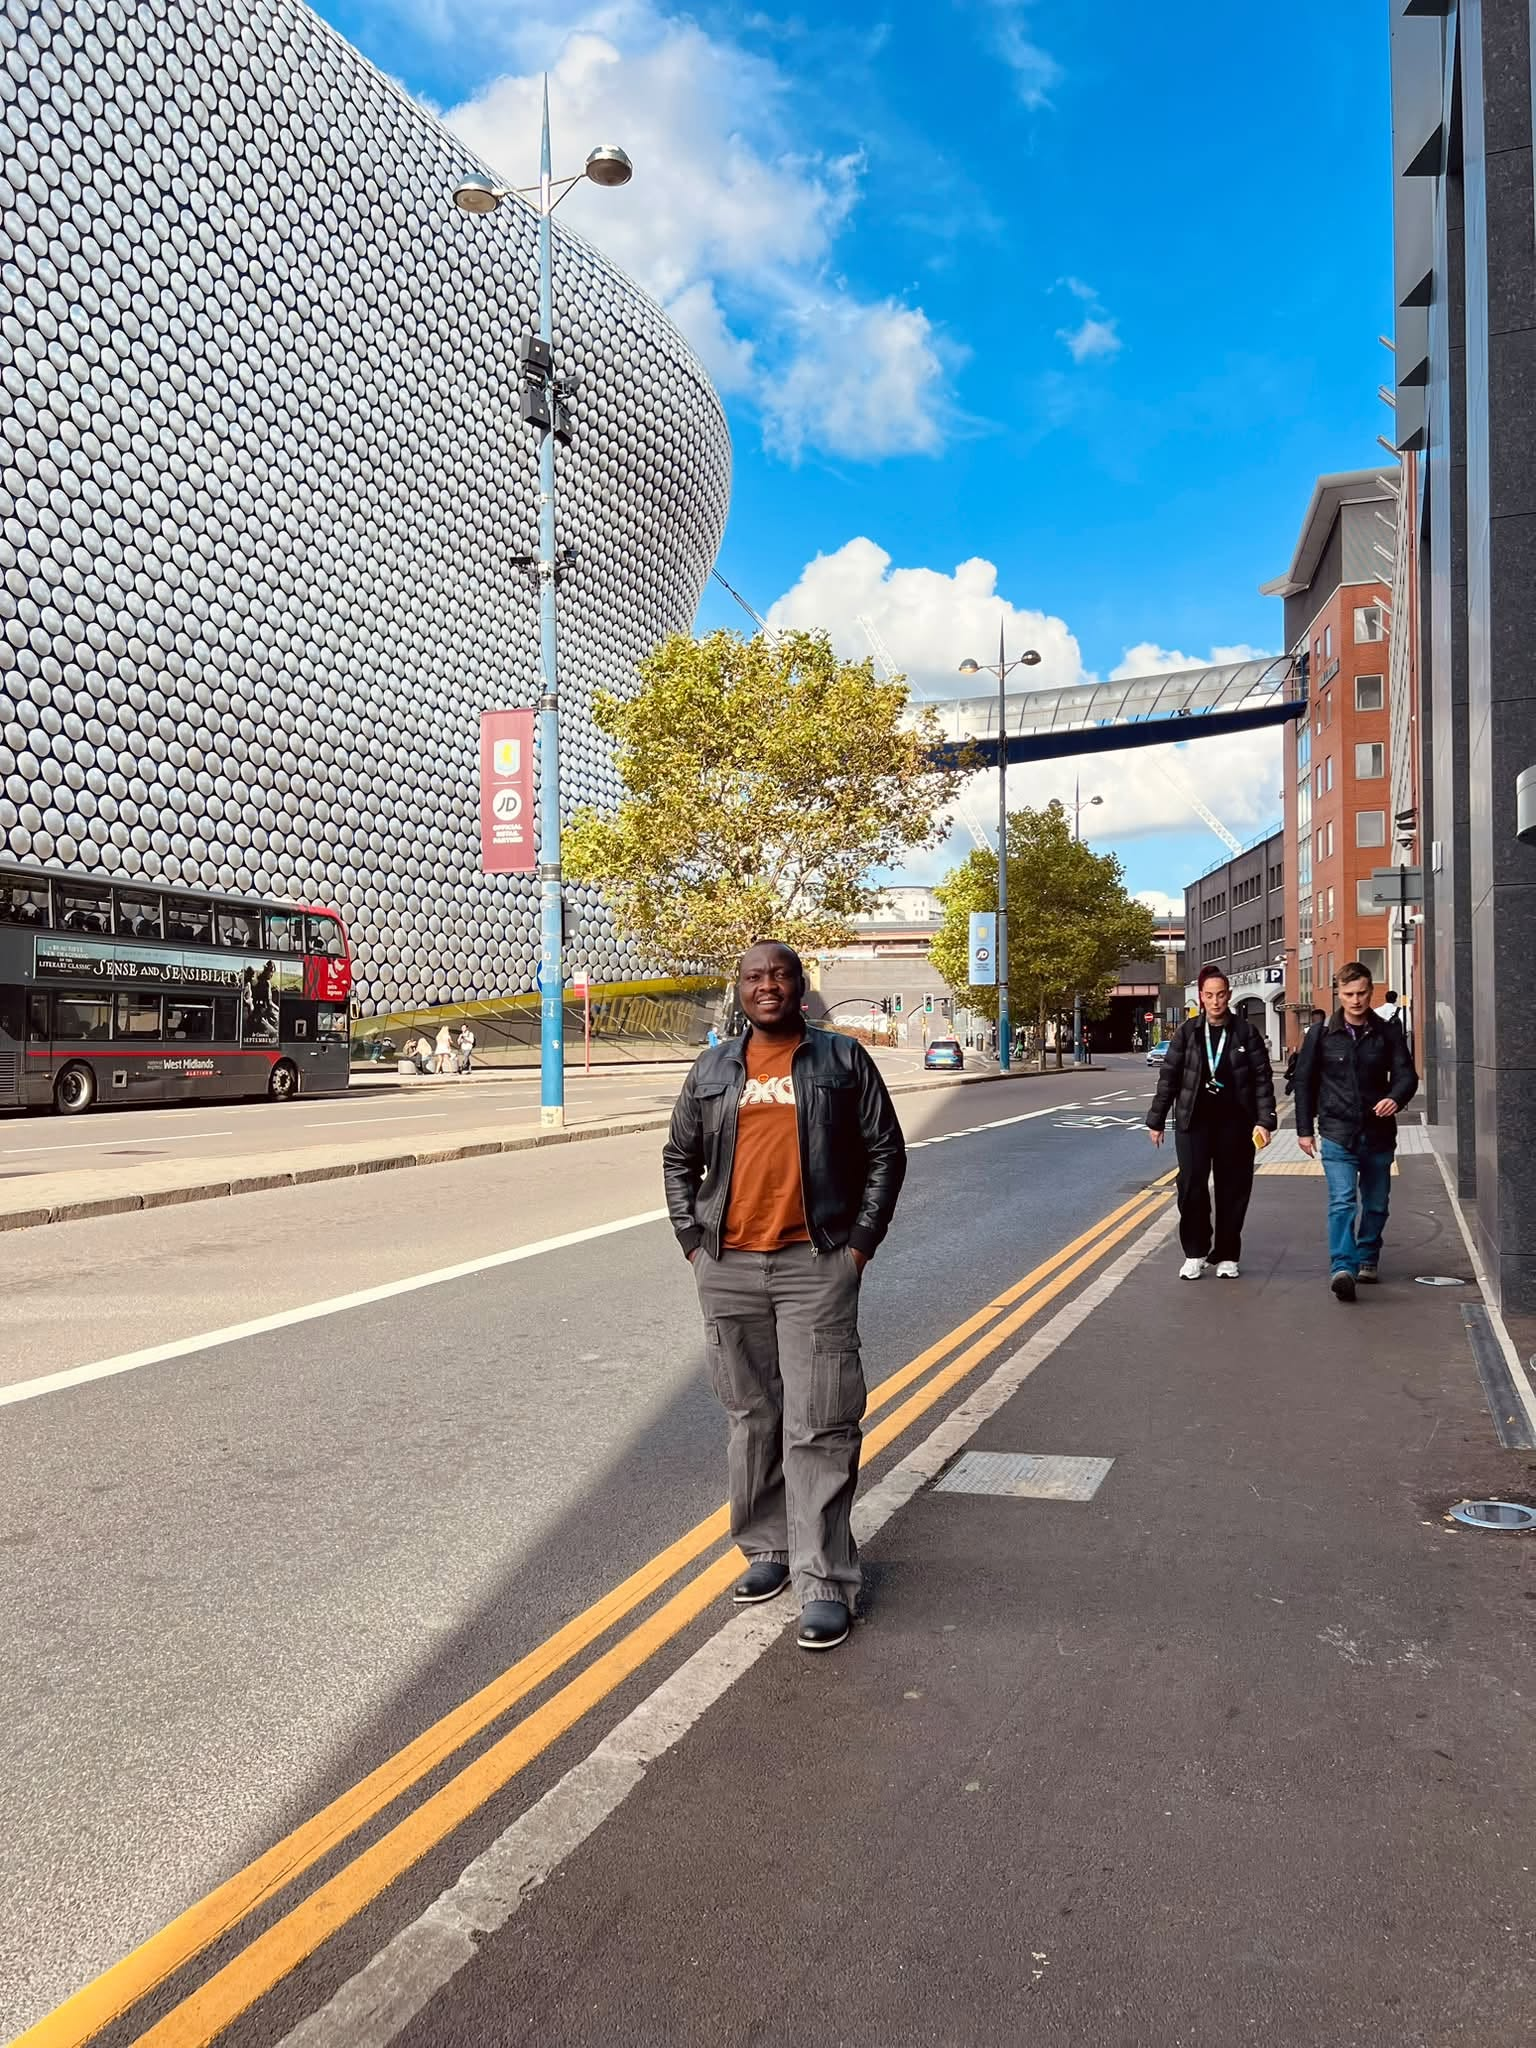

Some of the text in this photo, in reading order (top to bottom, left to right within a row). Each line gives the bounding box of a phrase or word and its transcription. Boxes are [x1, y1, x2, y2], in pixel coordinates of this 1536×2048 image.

[497, 797, 518, 812] JD
[93, 959, 242, 986] SENSE AND SENSIBILITY
[1270, 969, 1280, 981] P
[163, 1058, 214, 1070] West Midlands
